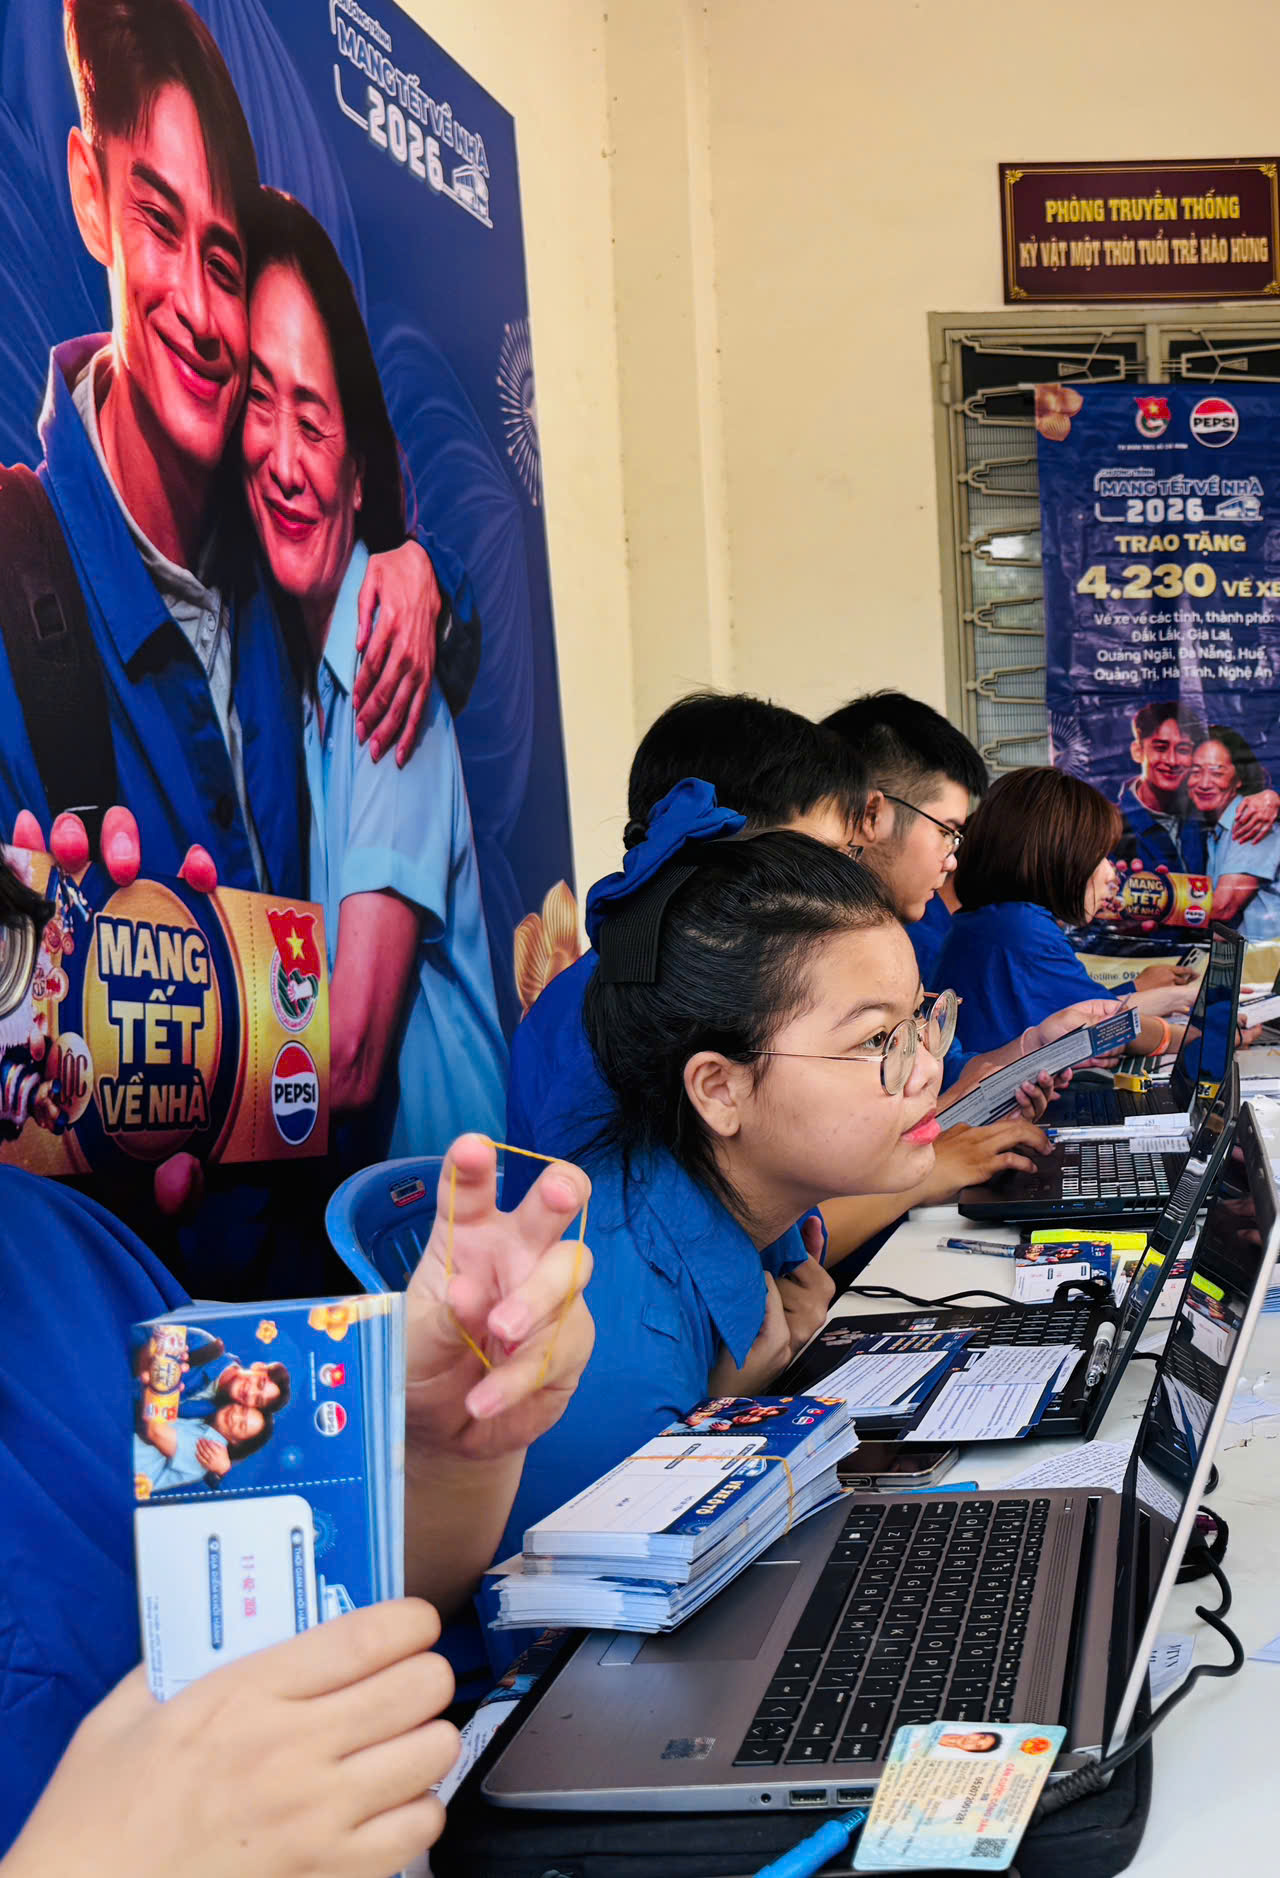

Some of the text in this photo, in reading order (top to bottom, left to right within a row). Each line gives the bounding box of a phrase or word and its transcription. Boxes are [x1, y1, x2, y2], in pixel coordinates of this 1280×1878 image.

[337, 16, 490, 178] MANG TẾT VỀ NHÀ
[367, 85, 444, 191] 2026
[1045, 187, 1240, 223] PHÒNG TRUYỀN THỐNG
[1040, 236, 1068, 271] VẬT
[1069, 234, 1100, 271] MỘT
[1103, 234, 1136, 266] THỜI
[1137, 229, 1170, 265] TUỔI
[1171, 232, 1198, 264] TRẺ
[1200, 232, 1228, 264] HÀO
[1230, 231, 1269, 263] HÙNG
[1193, 417, 1236, 429] PEPSI
[1101, 474, 1264, 497] MANG TẾT VỀ NHÀ
[1127, 498, 1204, 523] 2026
[1114, 531, 1247, 556] TRAO TẶNG
[1076, 562, 1217, 600] 4.230
[1222, 577, 1253, 598] VÉ
[1094, 612, 1112, 625] Vé
[1112, 615, 1131, 625] xe
[1149, 612, 1172, 624] các
[1205, 610, 1244, 624] thành
[1187, 629, 1210, 641] Gia
[1211, 628, 1234, 642] Lai,
[1096, 648, 1142, 663] Quảng
[1094, 666, 1140, 683] Quảng
[1162, 665, 1180, 678] Hà
[1218, 665, 1252, 682] Nghệ
[1254, 665, 1273, 678] An
[1128, 878, 1164, 892] MANG
[99, 920, 210, 984] MANG
[111, 987, 204, 1065] TẾT
[101, 1072, 207, 1126] VỀ NHÀ
[273, 1083, 316, 1104] PEPSI
